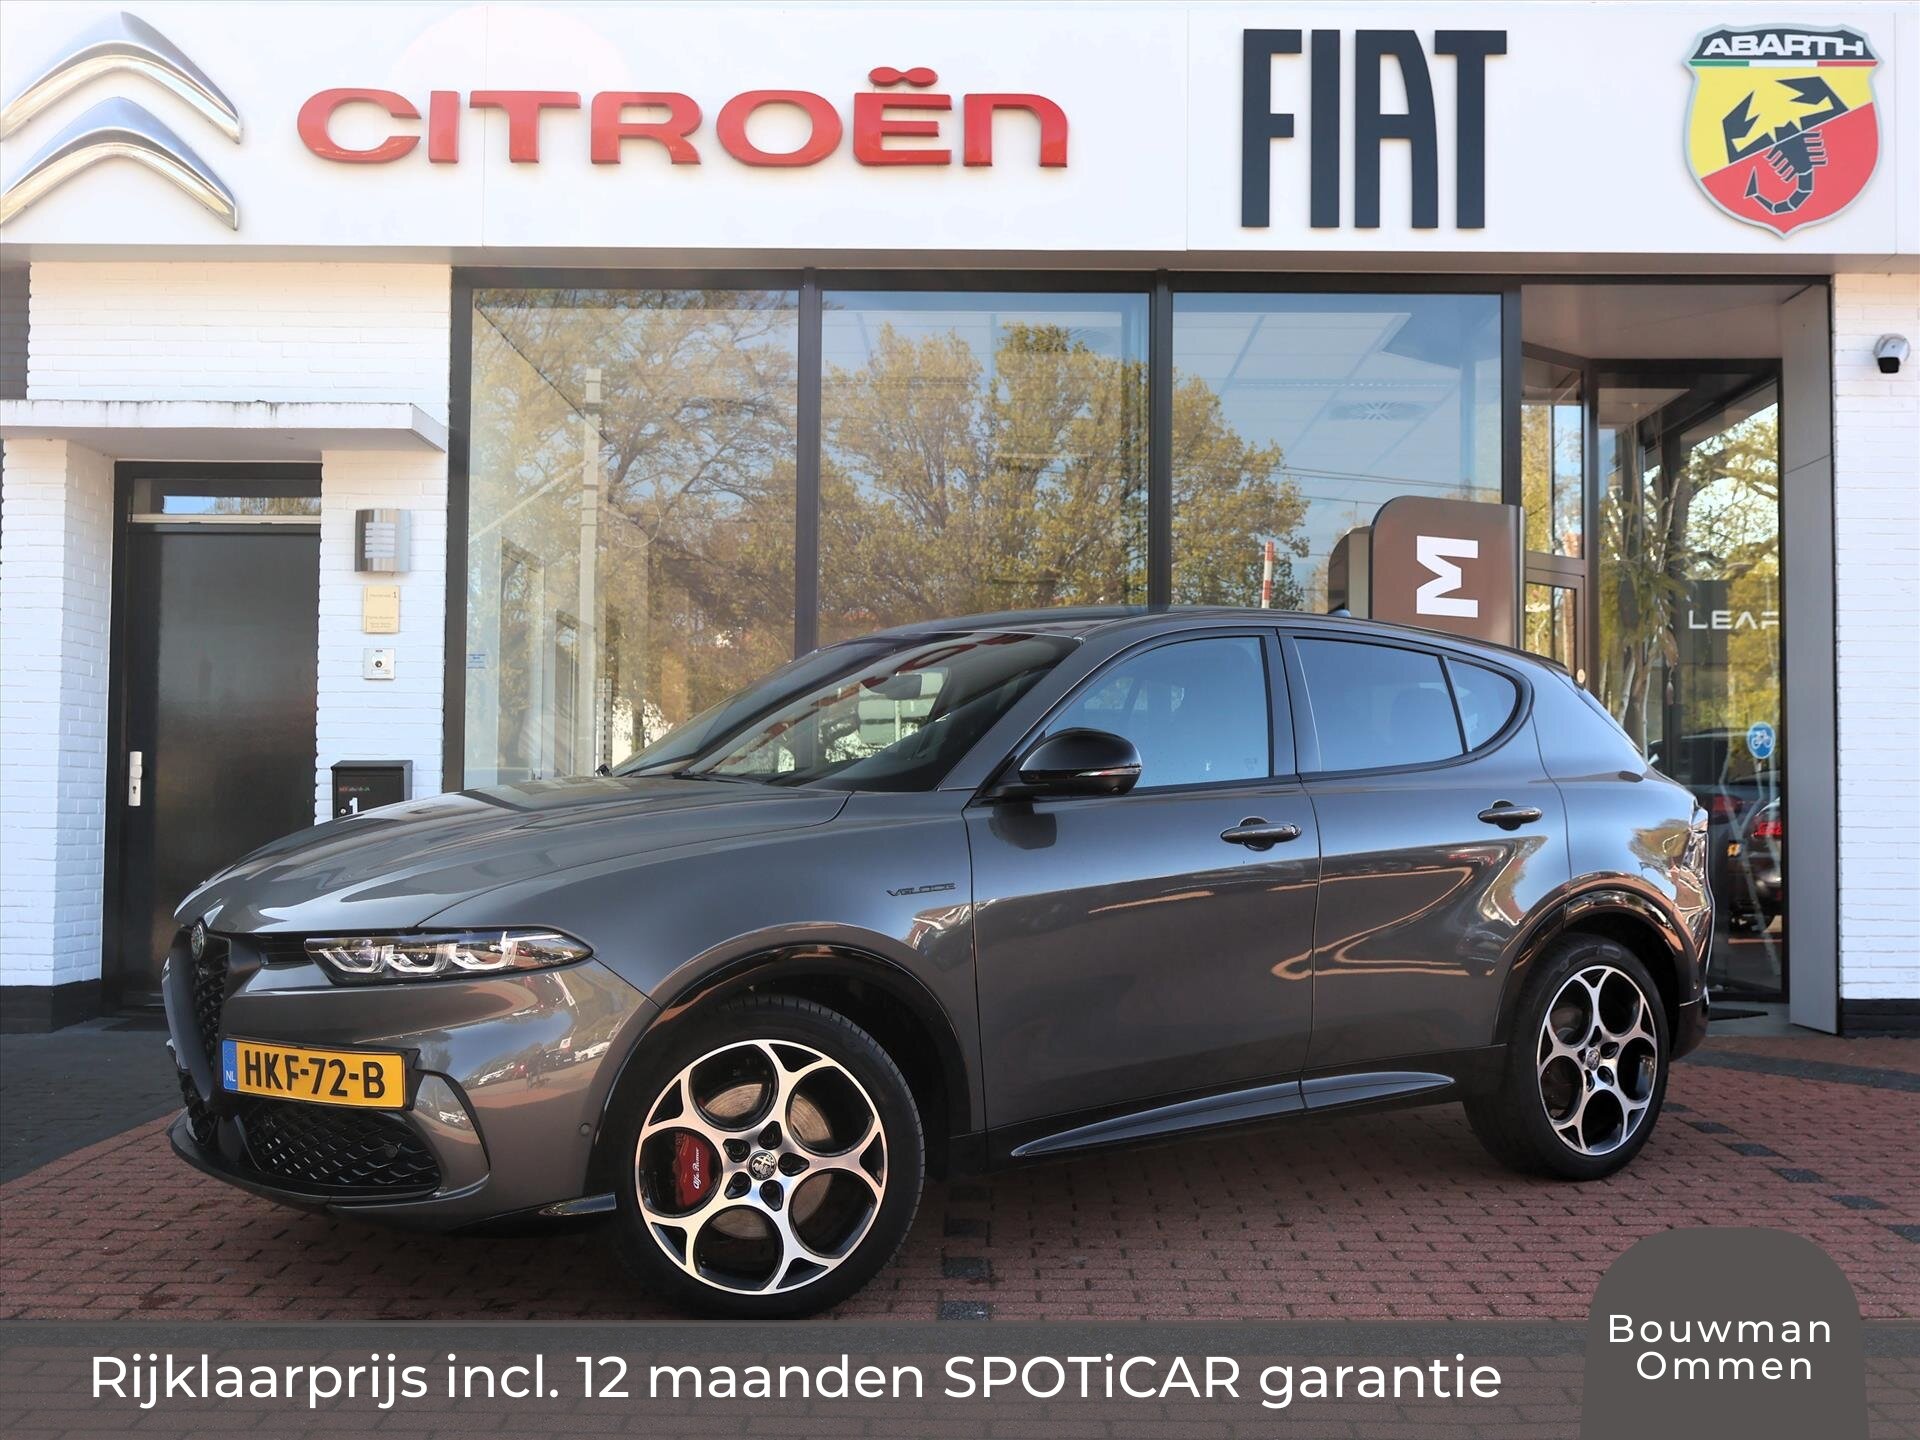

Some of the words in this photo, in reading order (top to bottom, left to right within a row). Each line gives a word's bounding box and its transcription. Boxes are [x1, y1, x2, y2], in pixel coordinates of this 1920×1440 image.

[1702, 33, 1864, 57] ABARTH
[1241, 28, 1507, 229] FIAT
[349, 796, 358, 815] 1
[886, 882, 956, 897] VELOCE
[225, 1070, 236, 1082] NL
[244, 1049, 386, 1099] HKF-72-B
